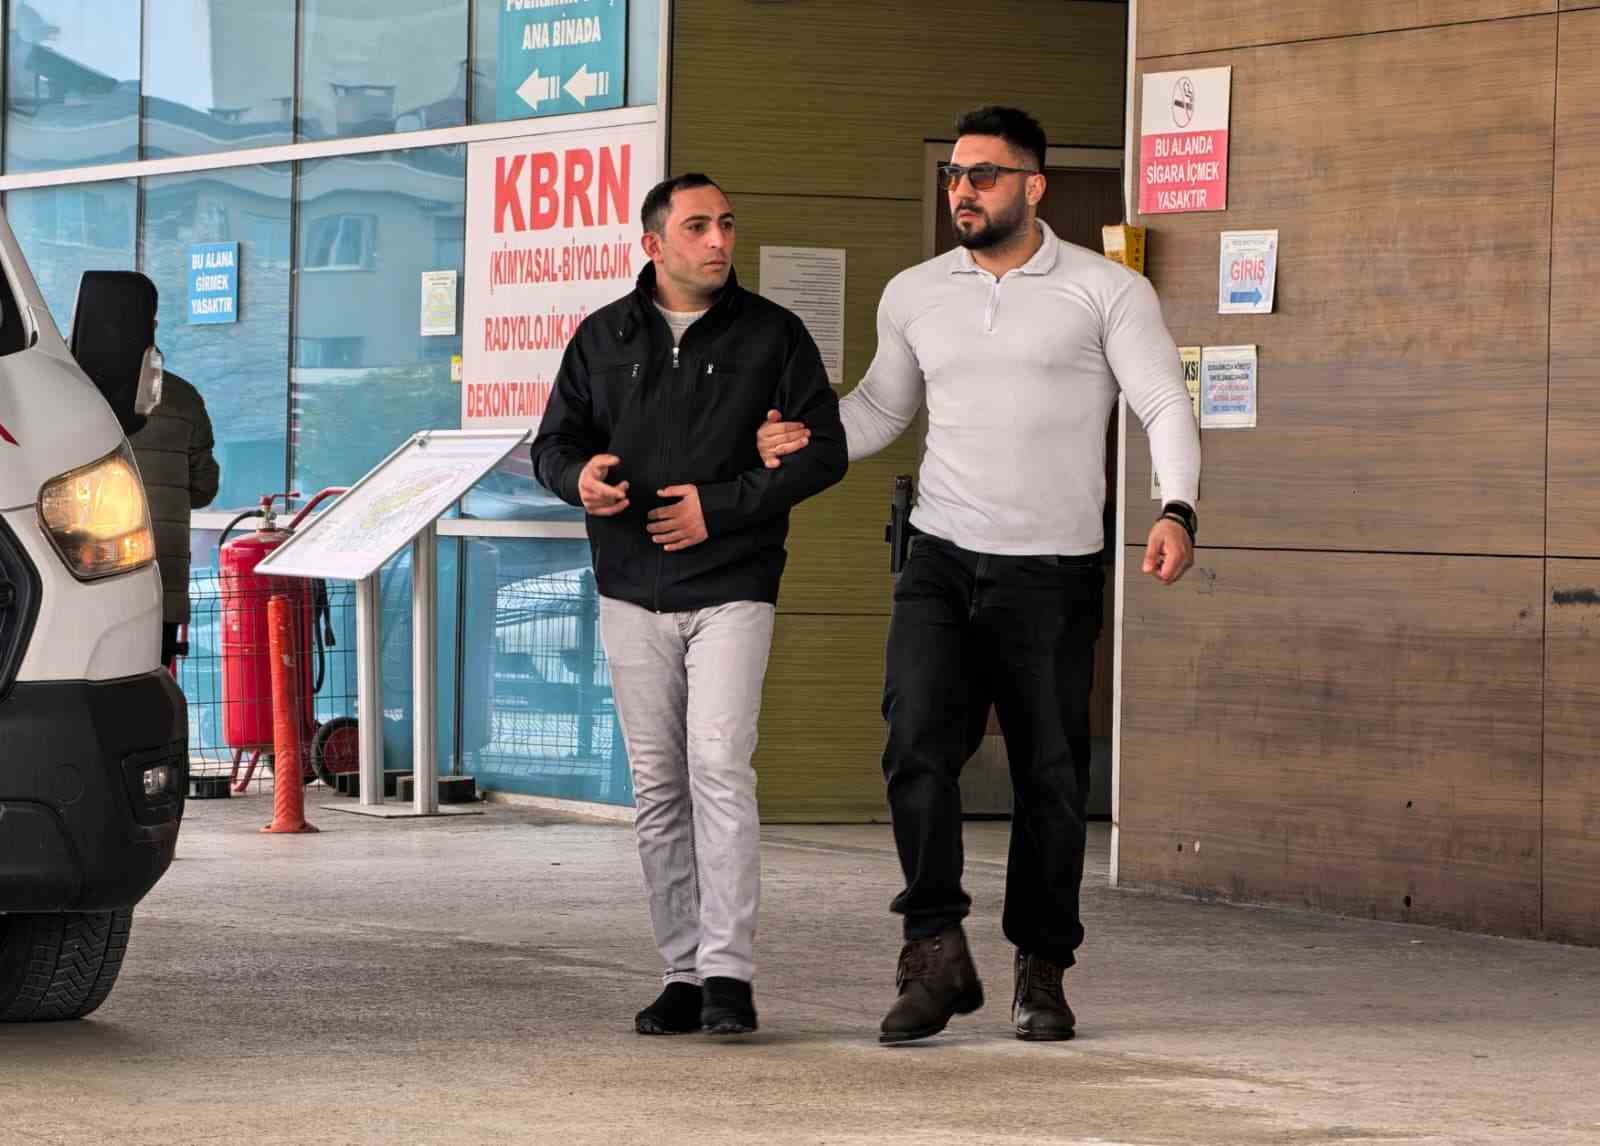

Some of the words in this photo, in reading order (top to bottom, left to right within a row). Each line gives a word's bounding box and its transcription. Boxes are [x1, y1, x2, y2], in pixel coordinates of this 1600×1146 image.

[522, 22, 549, 49] ANA
[553, 11, 601, 47] BİNADA
[1155, 138, 1170, 157] BU
[1171, 136, 1213, 155] ALANDA
[1147, 162, 1185, 184] SİGARA
[1187, 160, 1219, 184] İÇMEK
[494, 144, 631, 233] KBRN
[1157, 189, 1207, 208] YASAKTIR
[191, 253, 204, 270] BU
[205, 249, 234, 267] ALANA
[1231, 256, 1265, 285] GİRİŞ
[195, 272, 229, 292] GİRMEK
[191, 297, 233, 314] YASAKTIR
